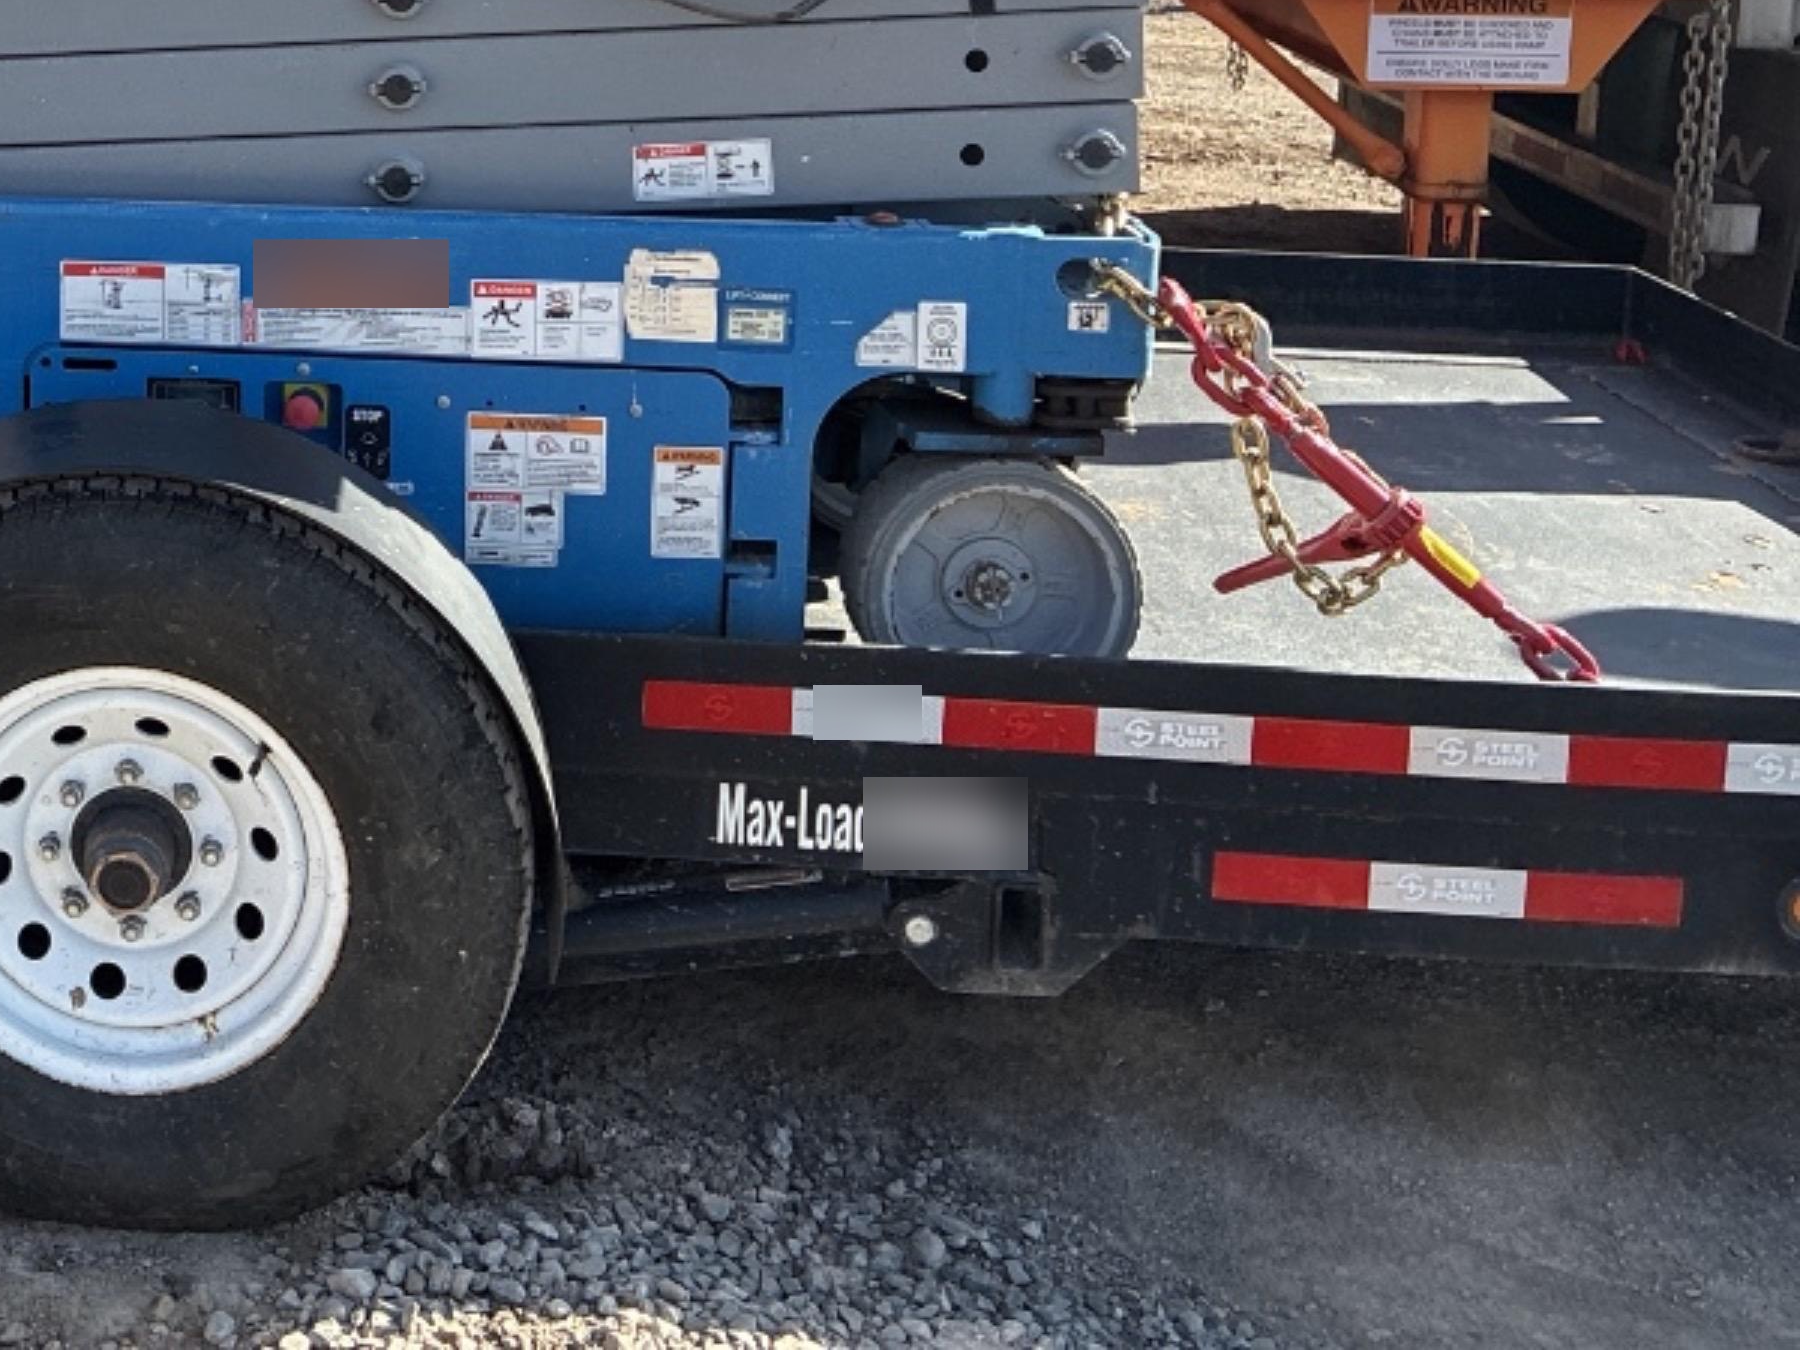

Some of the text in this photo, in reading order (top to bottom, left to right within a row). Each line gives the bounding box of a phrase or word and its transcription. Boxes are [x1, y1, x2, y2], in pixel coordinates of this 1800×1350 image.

[1159, 721, 1222, 736] STEEL
[1159, 734, 1226, 750] POINT
[1473, 740, 1535, 755] STEEL
[1473, 753, 1540, 769] POINT
[1431, 878, 1493, 891] STEEL
[1430, 889, 1496, 904] POINT
